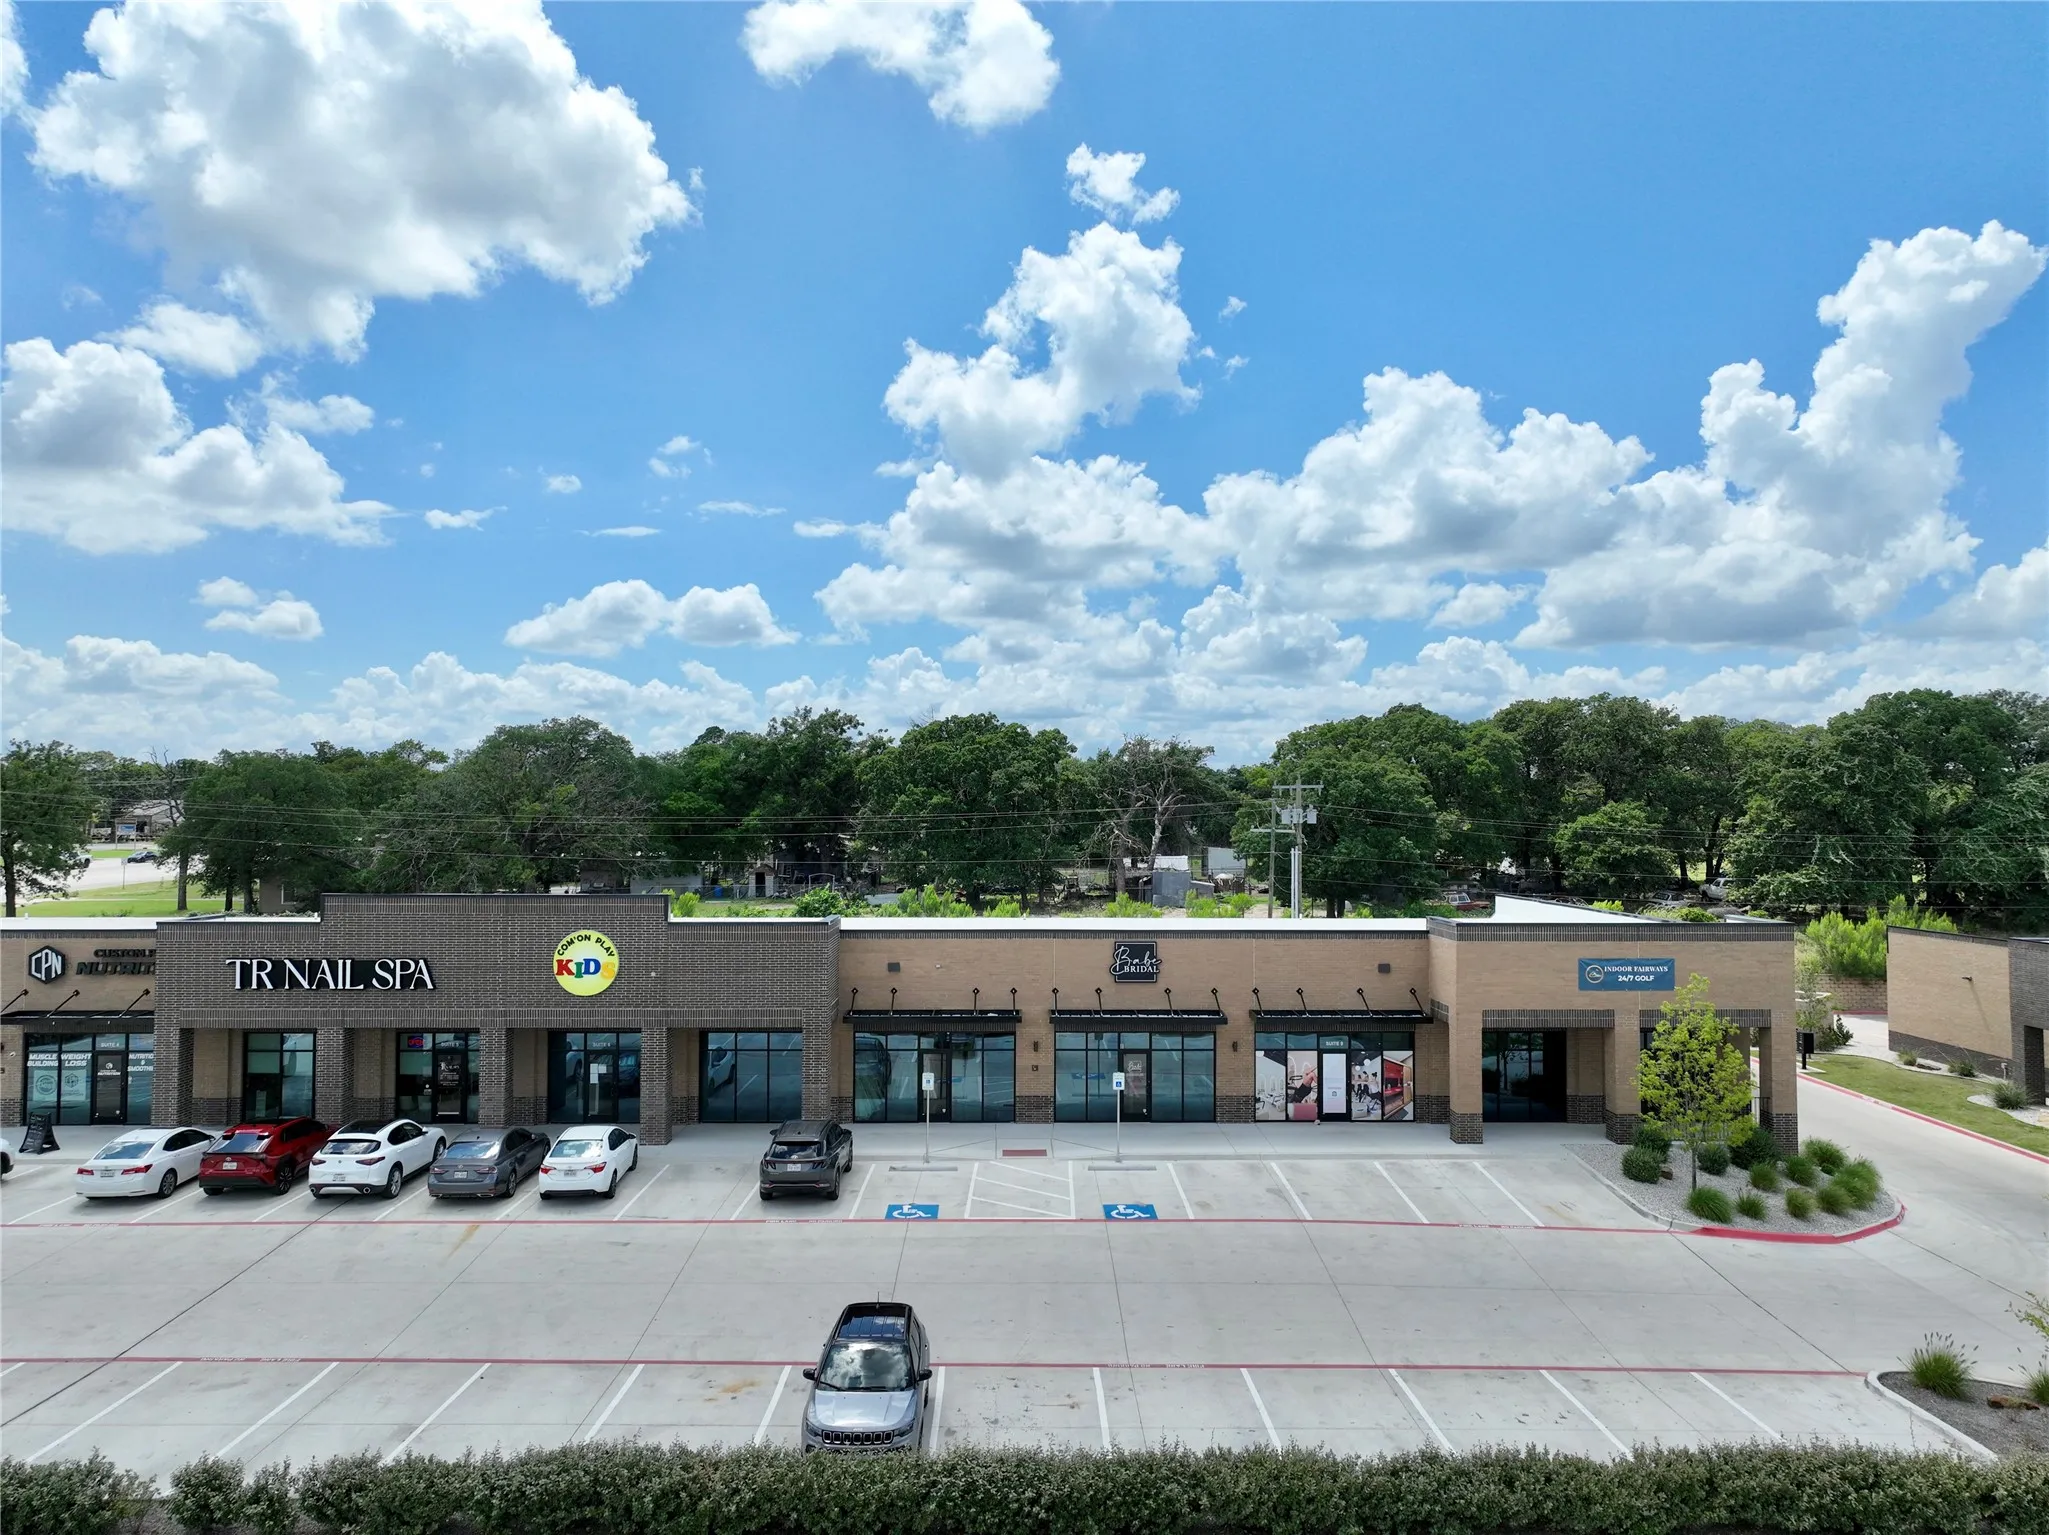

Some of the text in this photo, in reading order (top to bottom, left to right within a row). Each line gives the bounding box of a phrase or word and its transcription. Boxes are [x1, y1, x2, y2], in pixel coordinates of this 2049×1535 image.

[557, 934, 615, 957] COM'ON PLAY
[31, 949, 62, 981] CPN
[555, 958, 616, 979] KIDS
[1110, 945, 1162, 975] Babe
[1124, 965, 1160, 973] BRIDAL
[225, 958, 434, 990] TR NAIL SPA
[1618, 974, 1634, 982] 24/7
